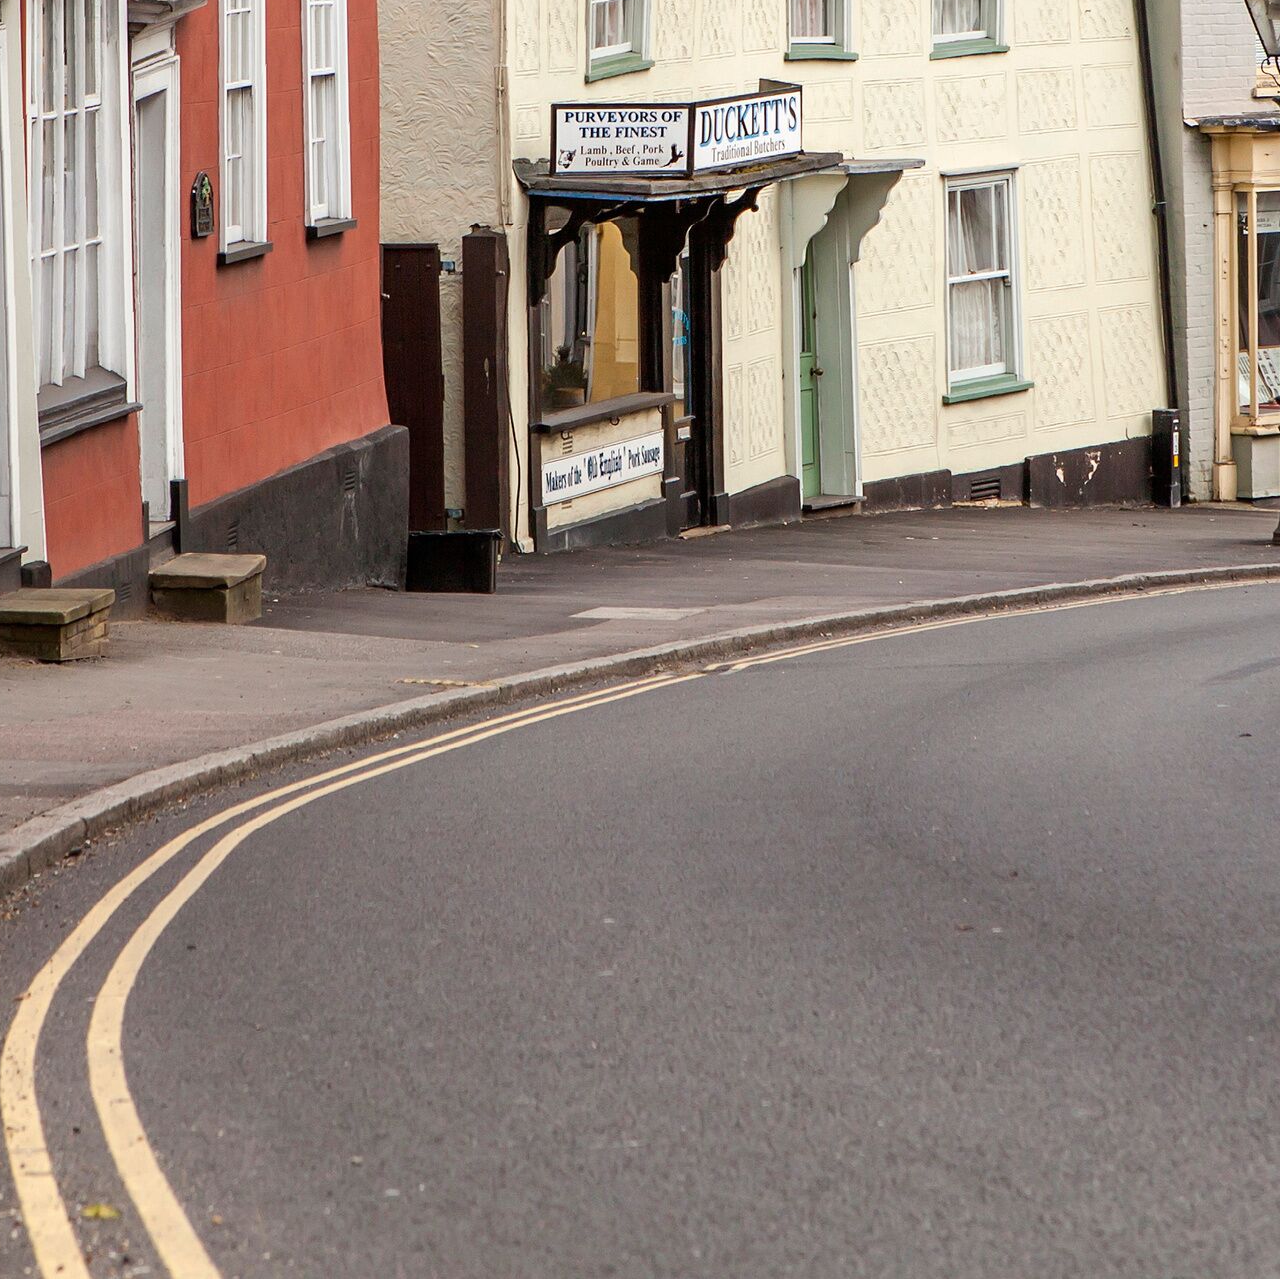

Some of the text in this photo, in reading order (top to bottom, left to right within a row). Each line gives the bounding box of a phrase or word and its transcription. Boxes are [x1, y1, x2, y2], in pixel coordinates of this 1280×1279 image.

[565, 111, 683, 123] PURVEYORS OF
[700, 96, 797, 146] DUCKETT'S
[579, 126, 667, 138] THE FINEST
[642, 144, 664, 155] Pork
[711, 138, 785, 163] Traditional Butchers
[585, 156, 659, 169] Poultry & Game
[545, 471, 567, 493] Makers
[567, 466, 574, 487] of
[574, 464, 582, 485] the
[628, 447, 641, 470] Pork
[641, 445, 661, 467] Sausage
